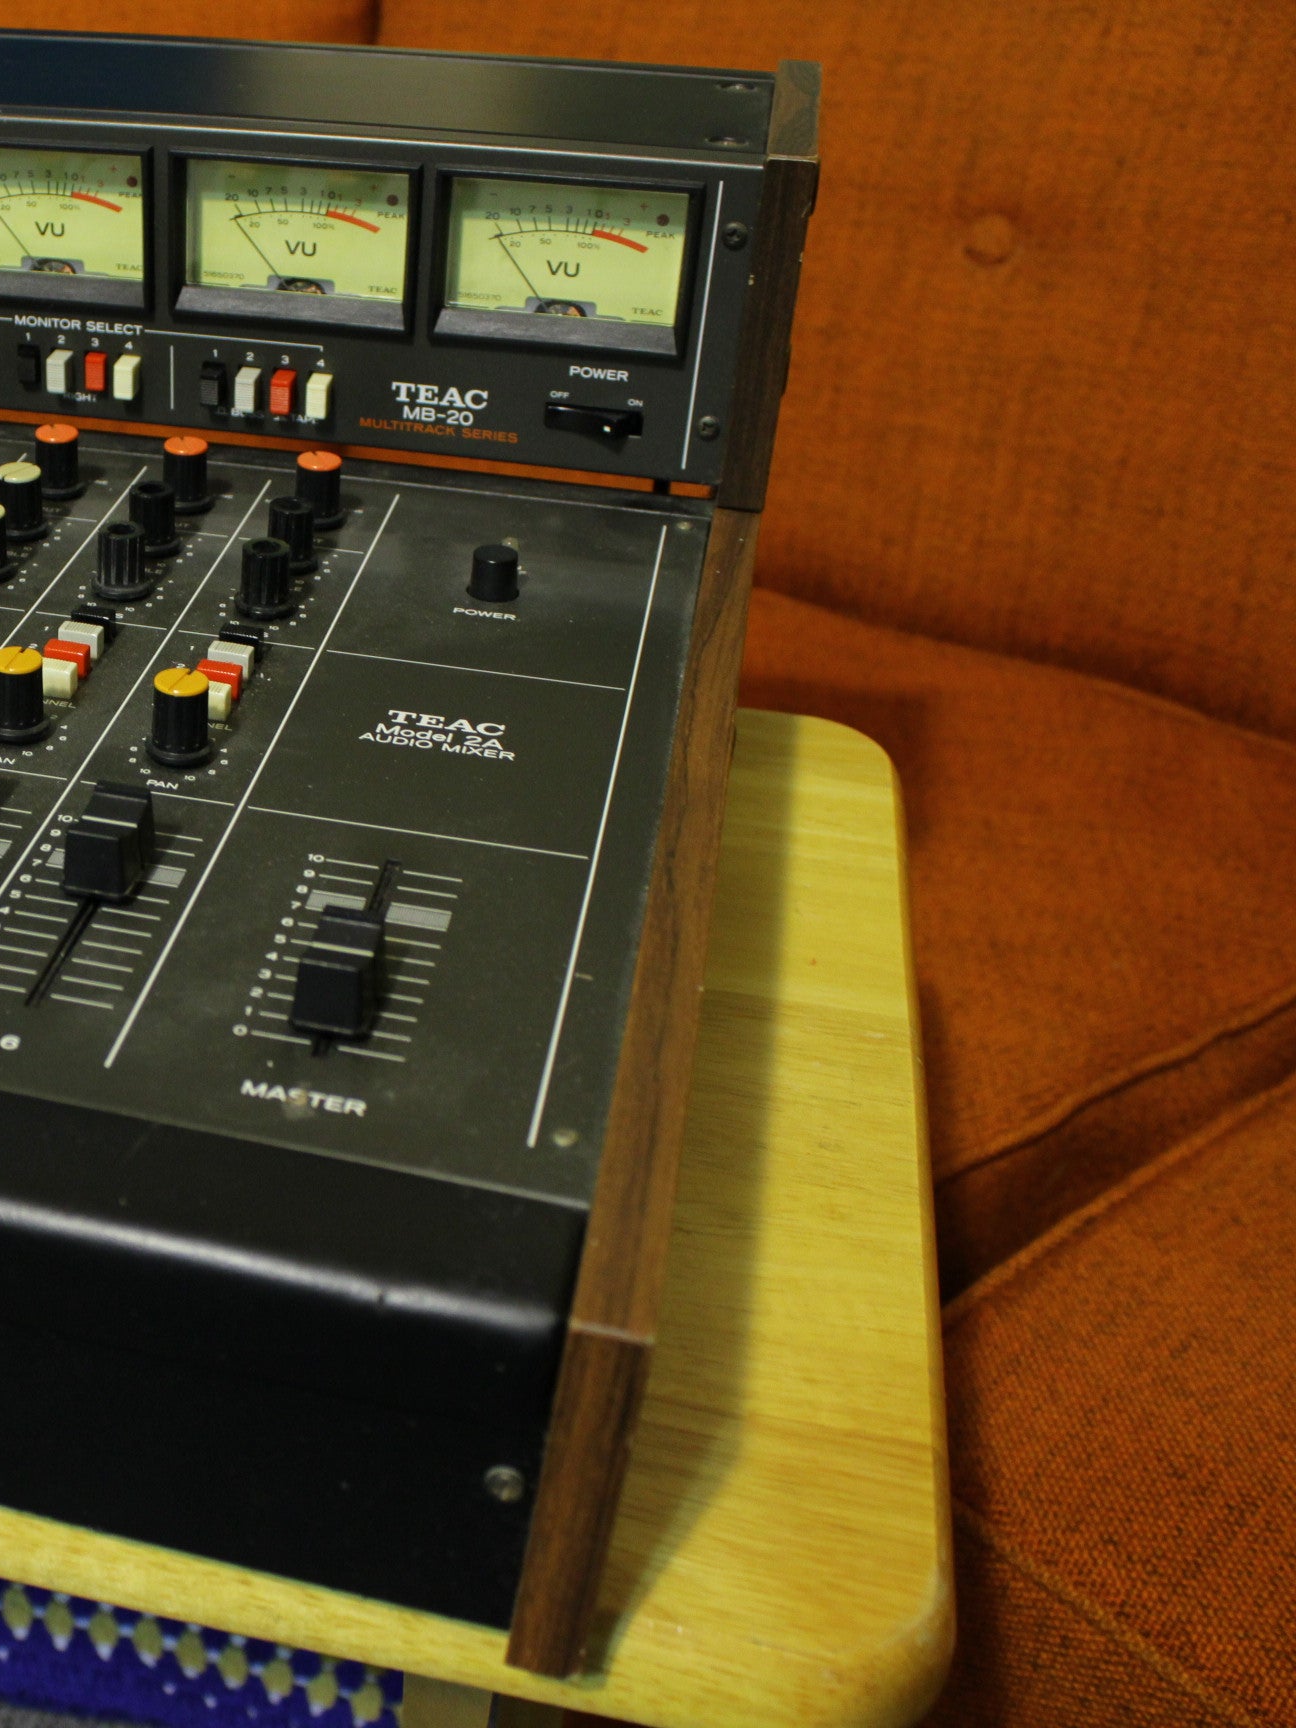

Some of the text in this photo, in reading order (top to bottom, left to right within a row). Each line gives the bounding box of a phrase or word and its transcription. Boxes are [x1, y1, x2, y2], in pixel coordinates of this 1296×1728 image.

[248, 189, 258, 197] 10
[328, 191, 336, 199] 0
[485, 212, 500, 220] 20
[510, 208, 521, 216] 10
[546, 205, 553, 213] 5
[566, 206, 573, 214] 3
[595, 210, 603, 218] 0
[35, 221, 65, 237] VU
[646, 231, 675, 239] PEAK
[285, 240, 317, 257] VU
[547, 260, 580, 277] VU
[368, 286, 397, 294] TEAC
[632, 307, 663, 316] TEAC
[14, 314, 144, 336] MONITOR SELECT
[57, 335, 66, 344] 2
[91, 338, 99, 347] 3
[125, 341, 133, 350] 4
[245, 352, 254, 361] 2
[281, 355, 289, 365] 3
[316, 359, 324, 367] 4
[568, 366, 629, 382] POWER
[391, 381, 489, 410] TEAC
[550, 390, 570, 399] OFF
[627, 398, 643, 407] ON
[402, 405, 474, 426] MB-20
[359, 417, 519, 444] MULTITRACK SERIES
[453, 607, 516, 621] POWER
[388, 710, 506, 737] TEAC
[375, 723, 504, 751] Model 2A
[358, 732, 515, 761] AUDIO MIXER
[146, 780, 178, 791] PAN
[309, 854, 324, 862] 10
[291, 901, 301, 909] 7
[233, 1025, 247, 1036] 0
[0, 1035, 20, 1050] 6
[240, 1079, 367, 1116] MASTER
